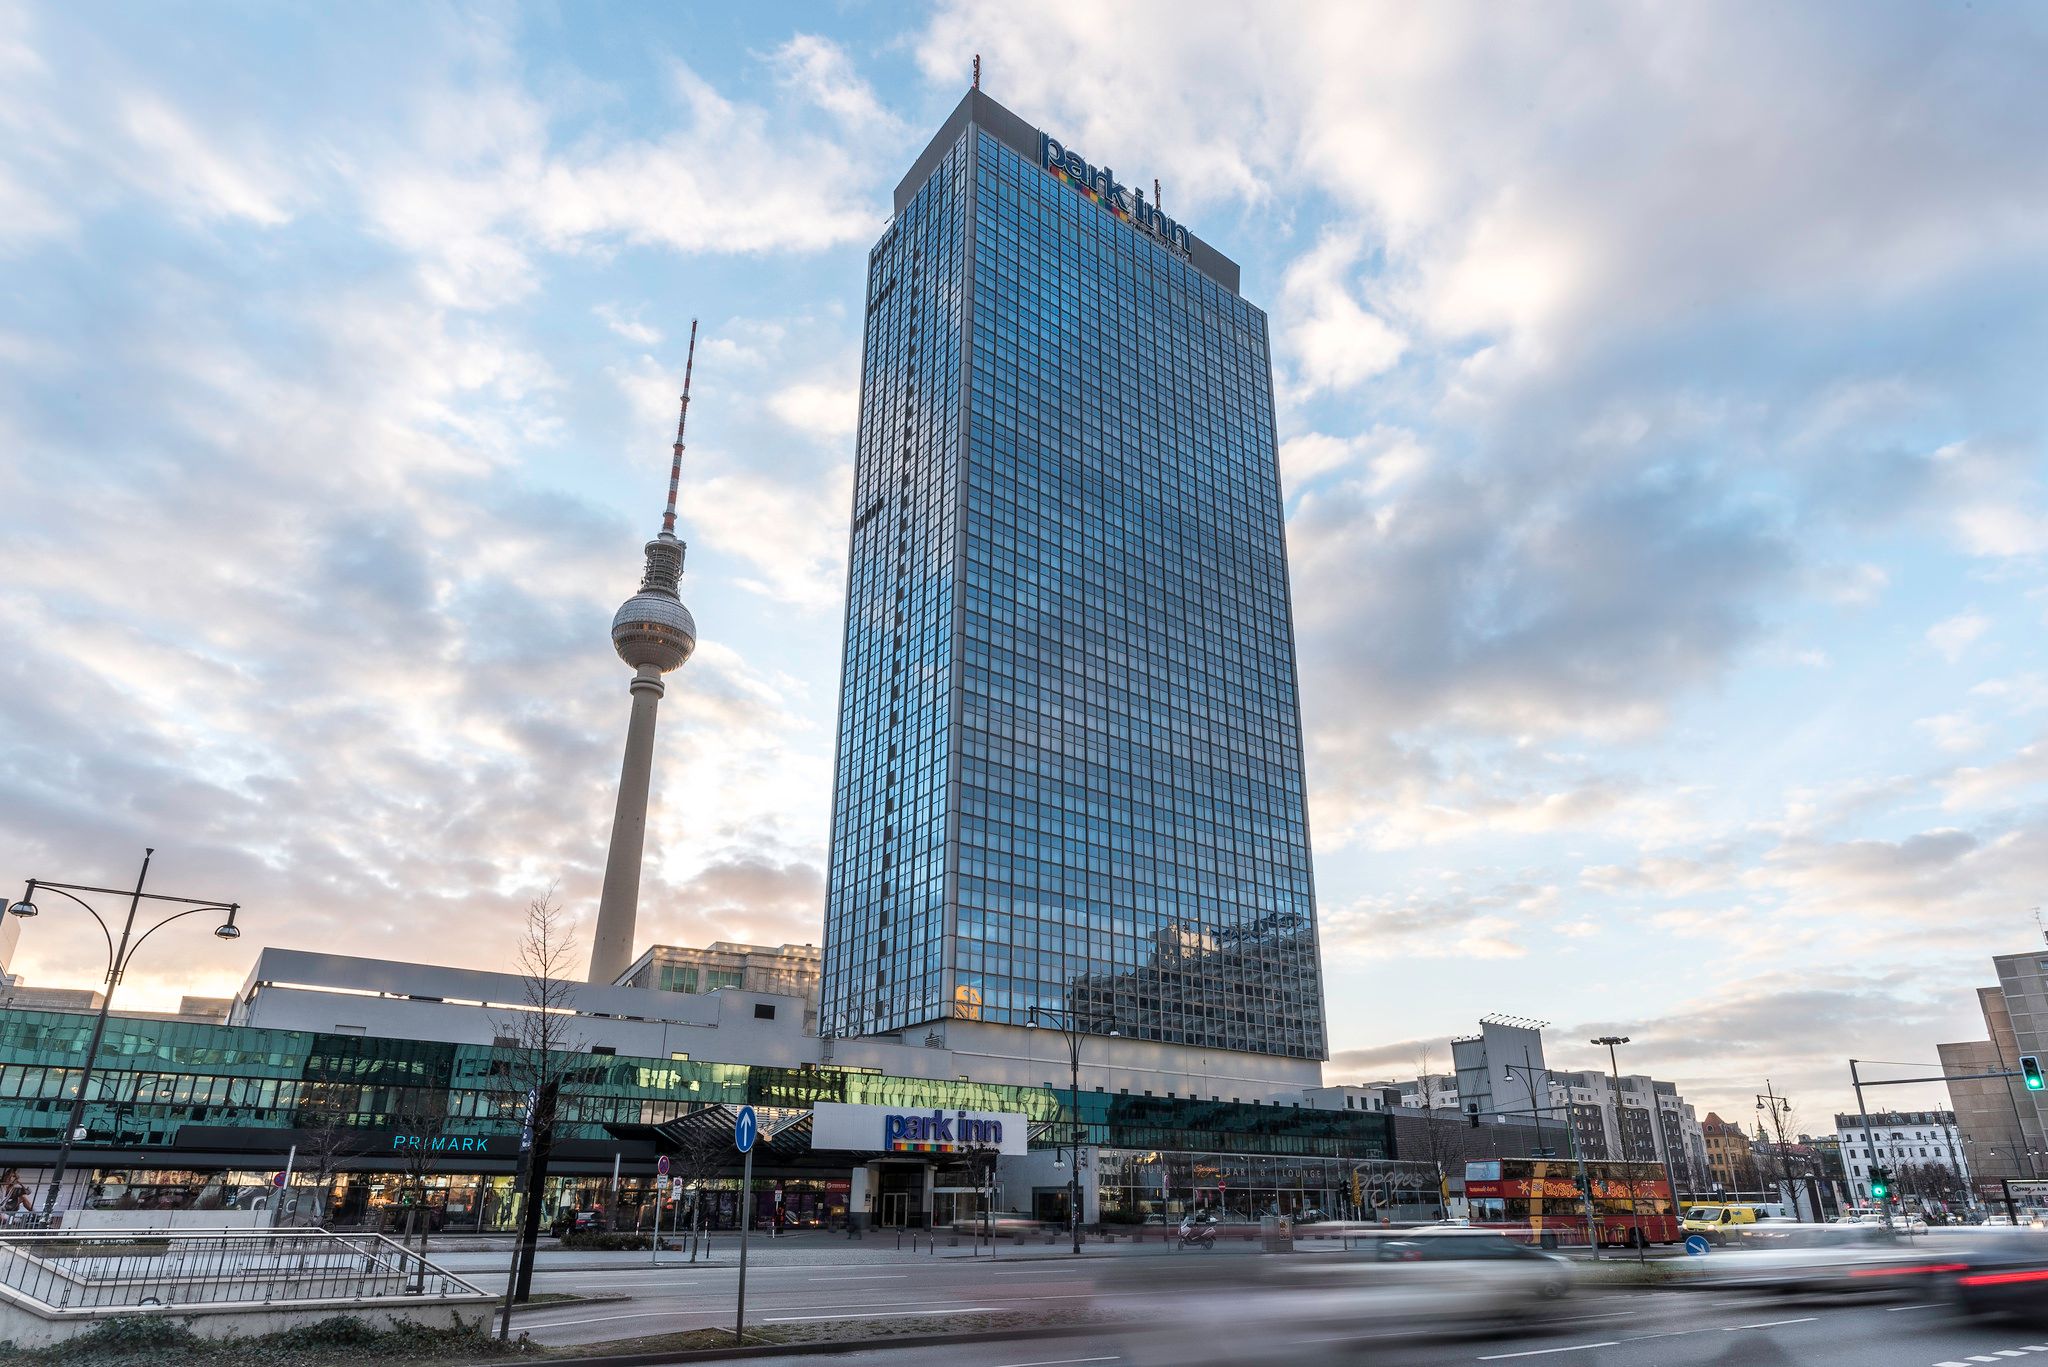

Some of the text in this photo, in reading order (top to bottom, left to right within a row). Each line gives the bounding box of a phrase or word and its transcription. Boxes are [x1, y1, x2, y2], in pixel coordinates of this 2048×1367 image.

[1040, 130, 1128, 213] park
[1135, 187, 1191, 253] inn
[393, 1135, 489, 1152] PRIMARK
[885, 1110, 1003, 1151] park inn
[1226, 1167, 1245, 1176] BAR
[1282, 1169, 1321, 1178] LOUNGE
